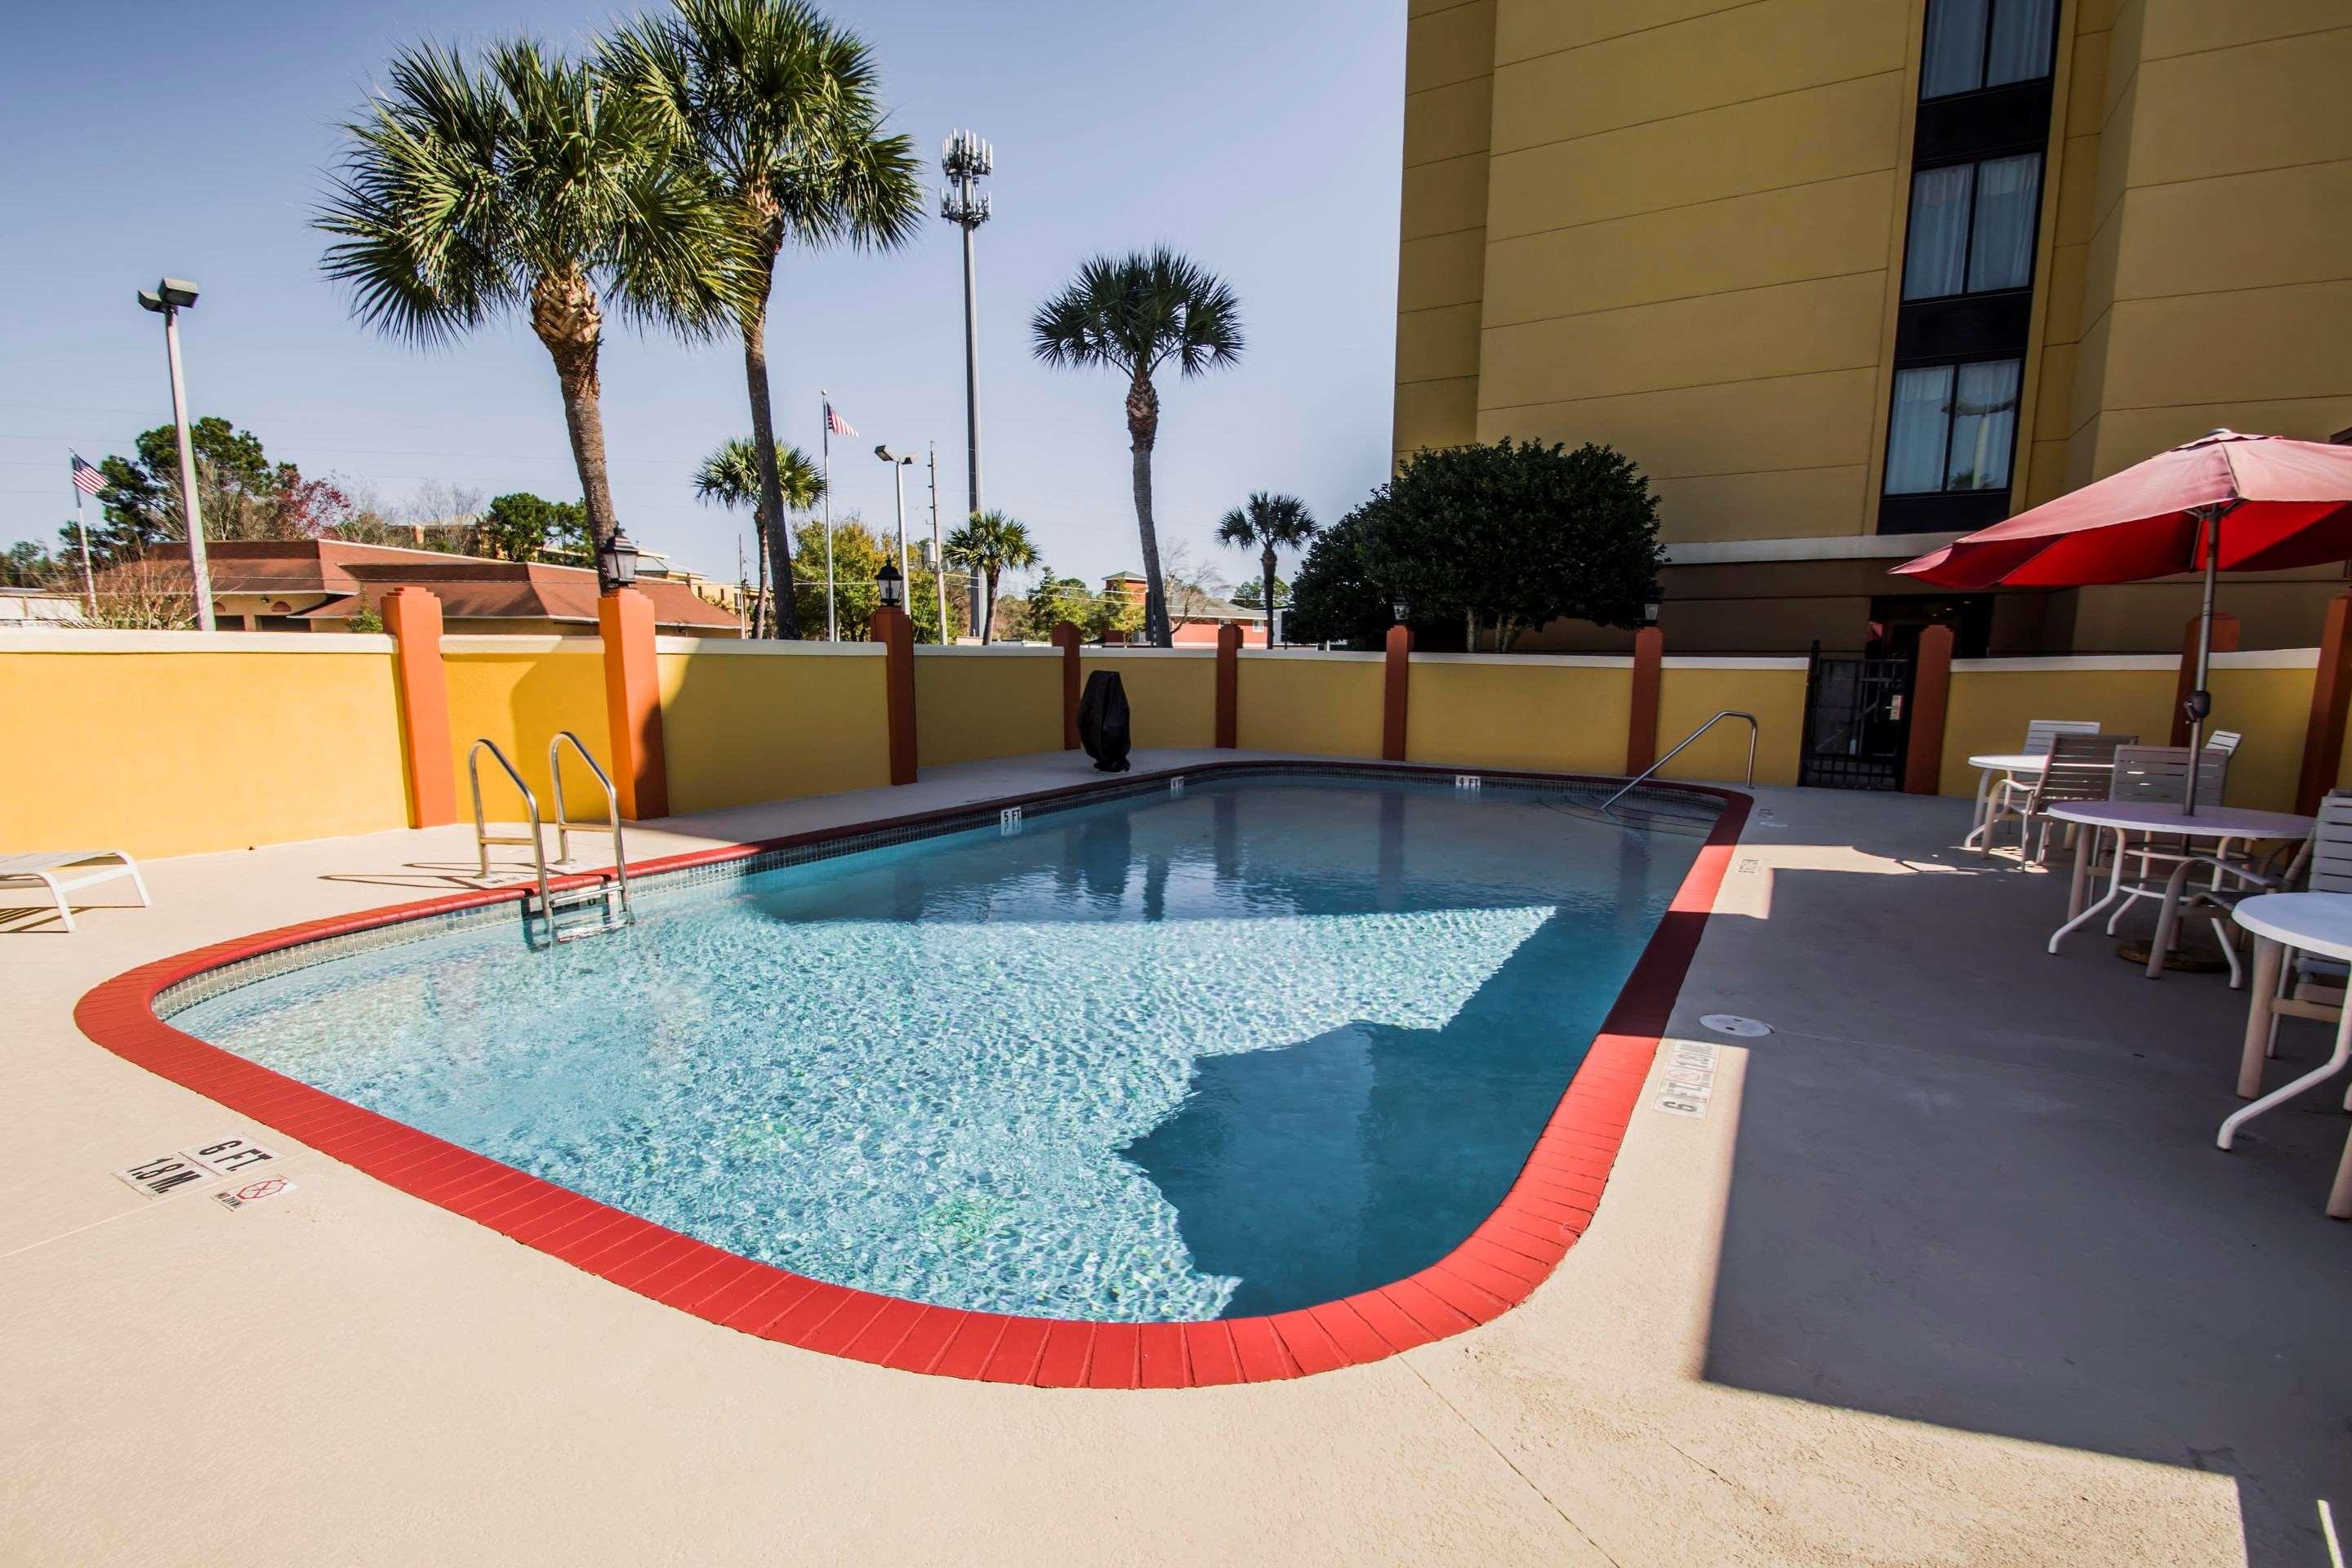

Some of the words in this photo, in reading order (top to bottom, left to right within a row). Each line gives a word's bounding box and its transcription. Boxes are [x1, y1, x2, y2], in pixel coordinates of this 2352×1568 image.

[1004, 811, 1009, 822] 5
[1012, 809, 1020, 821] FT
[1663, 1101, 1698, 1112] 6
[198, 1140, 243, 1156] 6
[127, 1157, 185, 1180] 1.8
